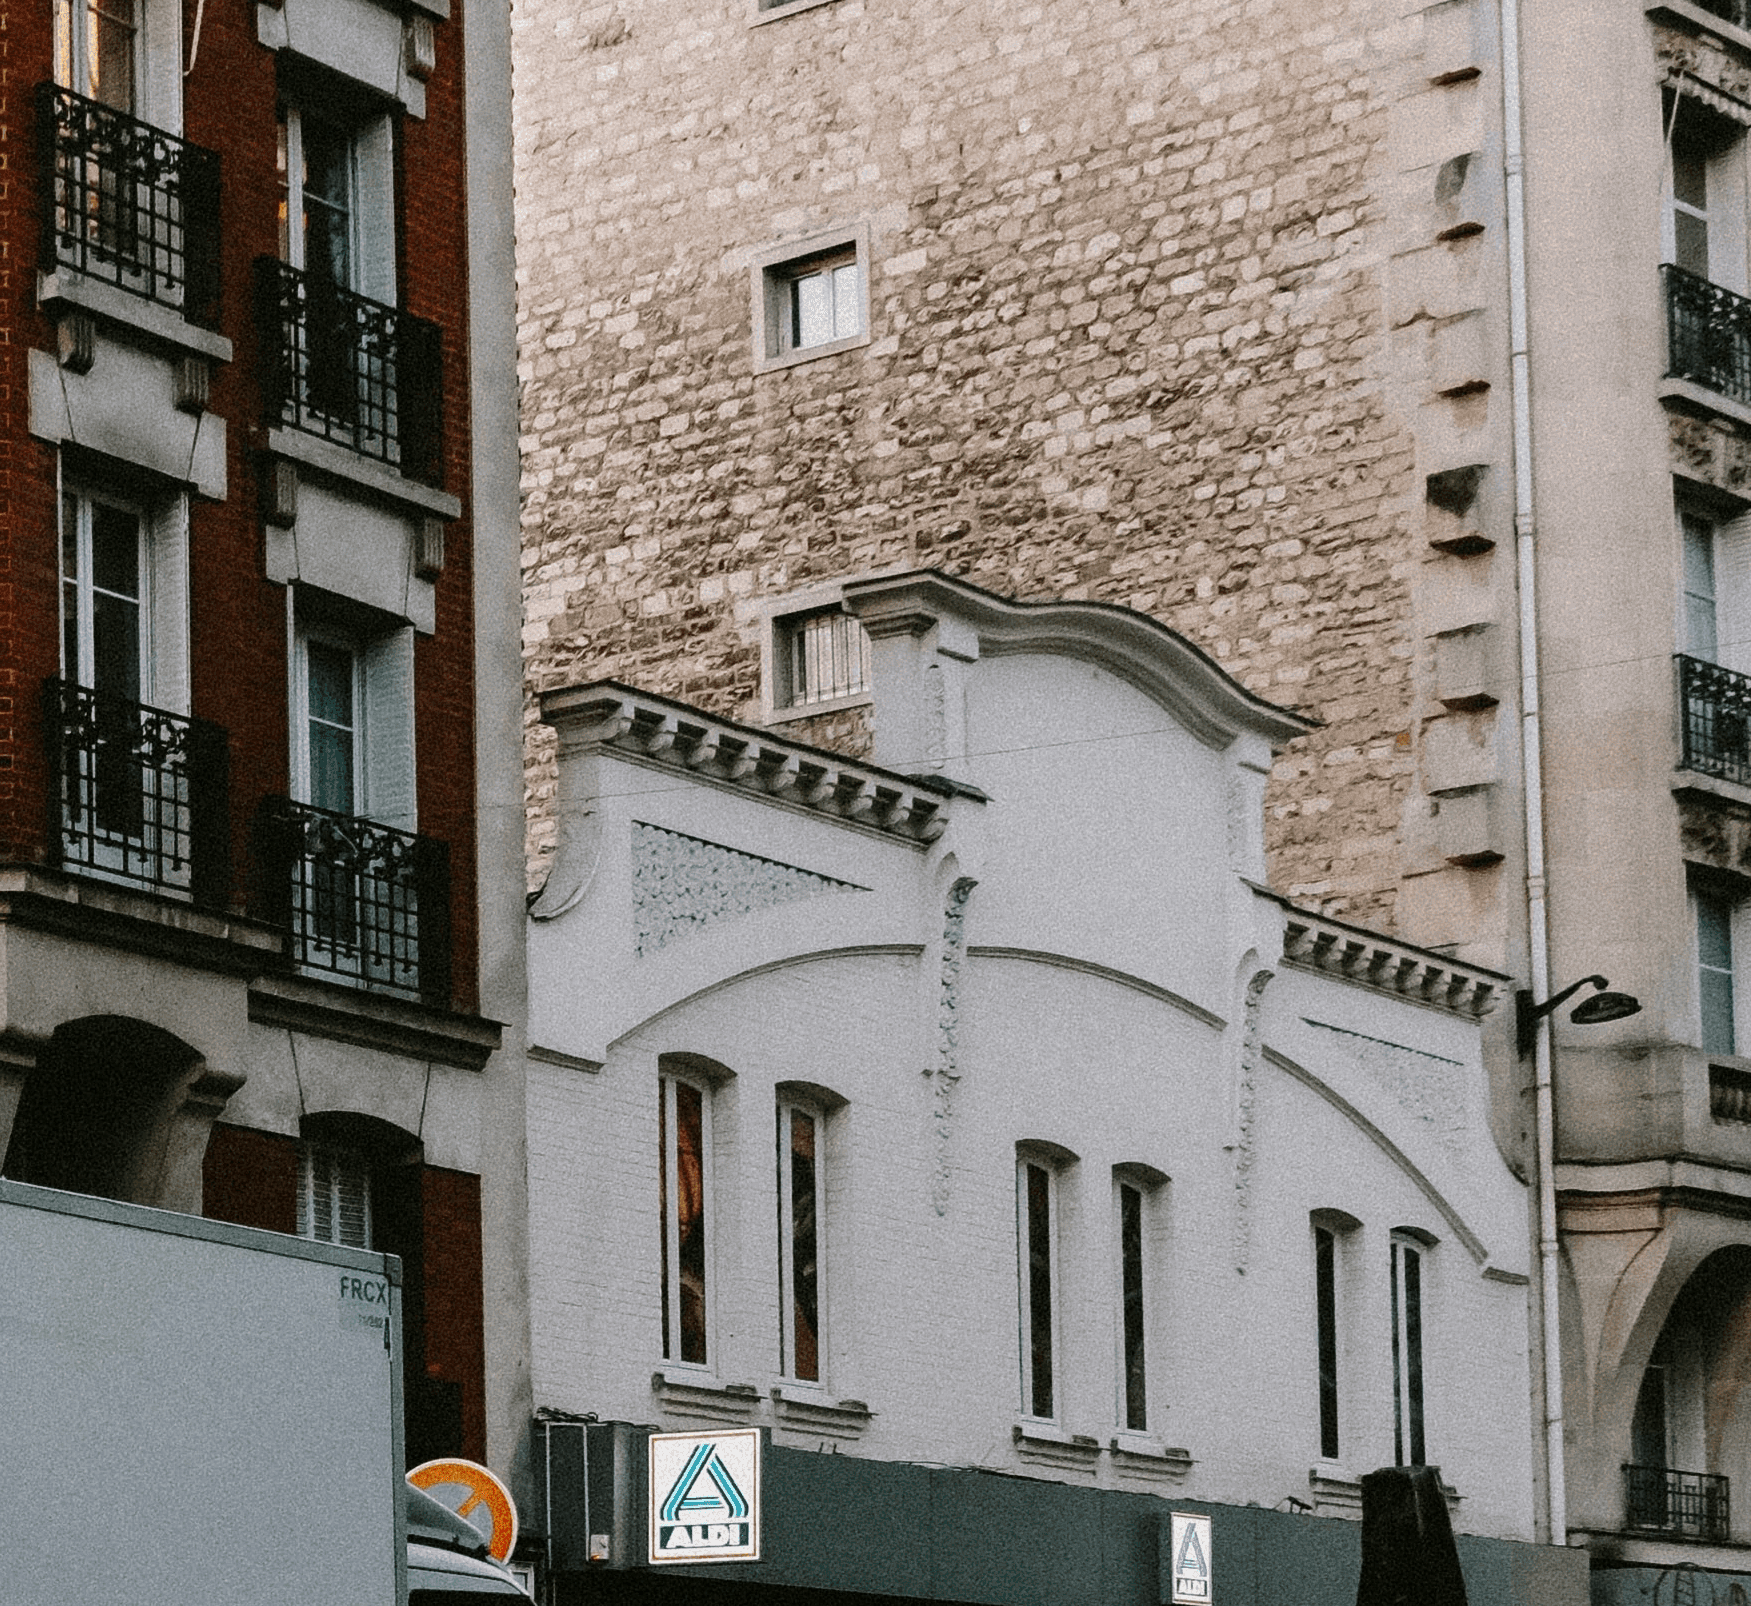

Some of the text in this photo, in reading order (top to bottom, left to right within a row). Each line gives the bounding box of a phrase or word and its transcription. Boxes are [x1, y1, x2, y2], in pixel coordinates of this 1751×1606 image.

[339, 1275, 387, 1304] FRCX
[665, 1524, 741, 1549] ALDI
[1177, 1578, 1206, 1596] ALDI
